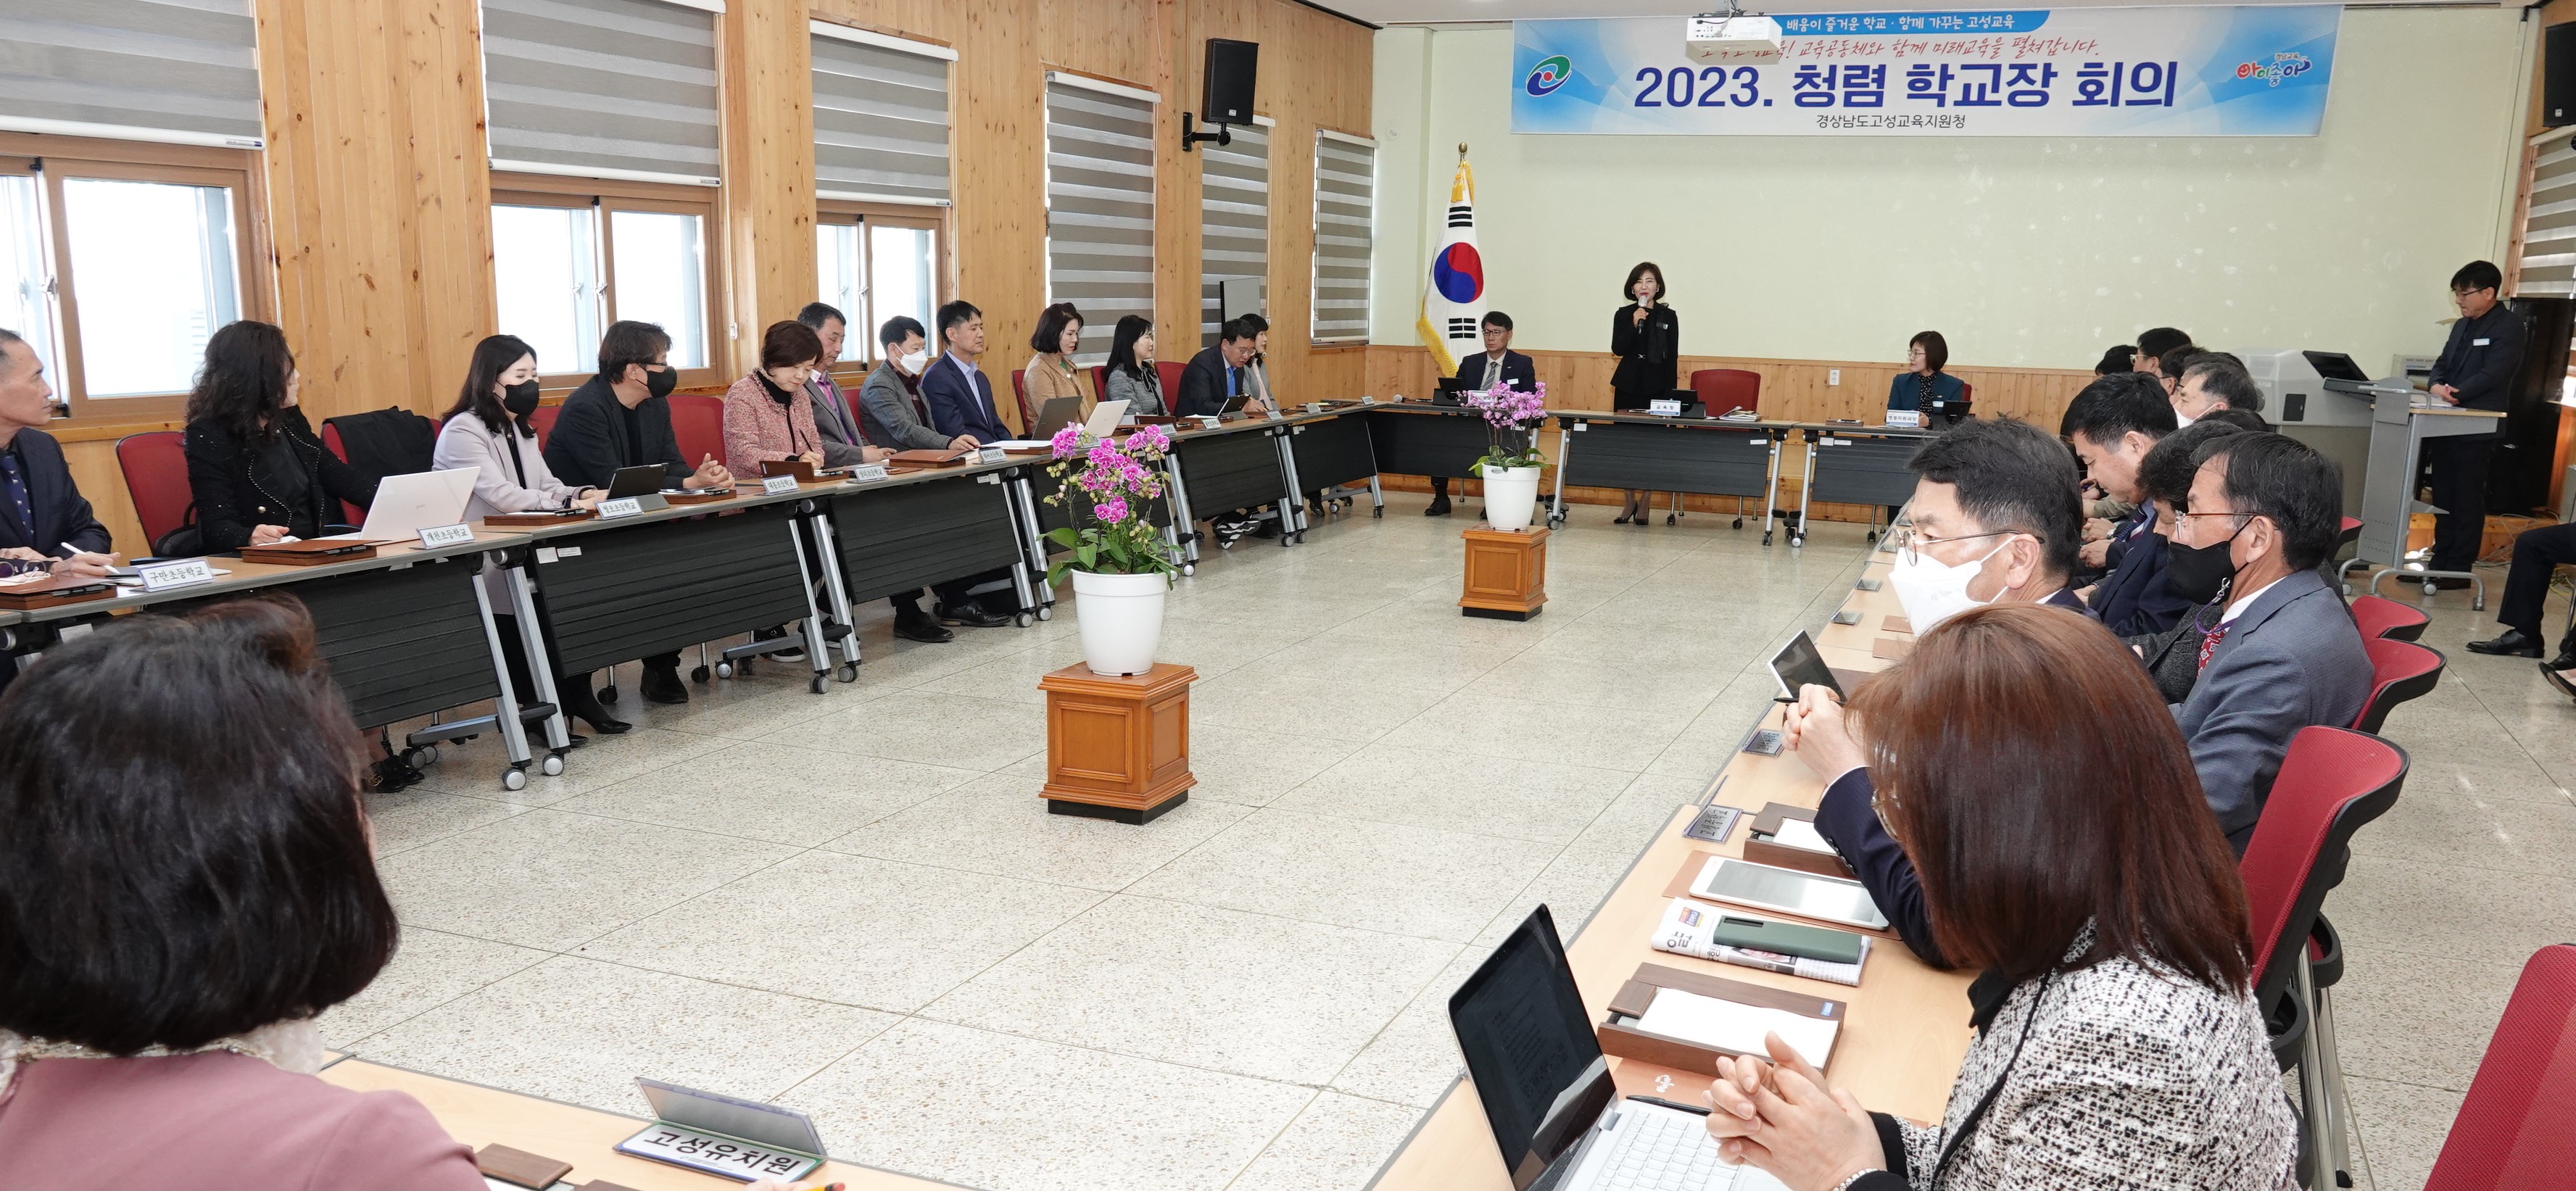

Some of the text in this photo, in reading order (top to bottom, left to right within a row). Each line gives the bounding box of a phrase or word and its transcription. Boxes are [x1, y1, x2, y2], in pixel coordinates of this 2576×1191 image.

[1786, 14, 2015, 32] 배움이 즐거운 학교 함께 가꾸는 고성교육
[1799, 40, 1885, 59] 교육공동체와
[1892, 39, 1928, 58] 함께
[1933, 37, 2004, 59] 미래교육을
[2011, 35, 2100, 59] 펼쳐갑니다.
[1634, 61, 2178, 108] 2023. 청렴 학교장 회의
[2237, 61, 2311, 87] 아이좋아
[1816, 115, 1966, 129] 경상남도고성교육지원청
[149, 566, 205, 583] 구만초등학교
[643, 1131, 801, 1176] 고성유치원
